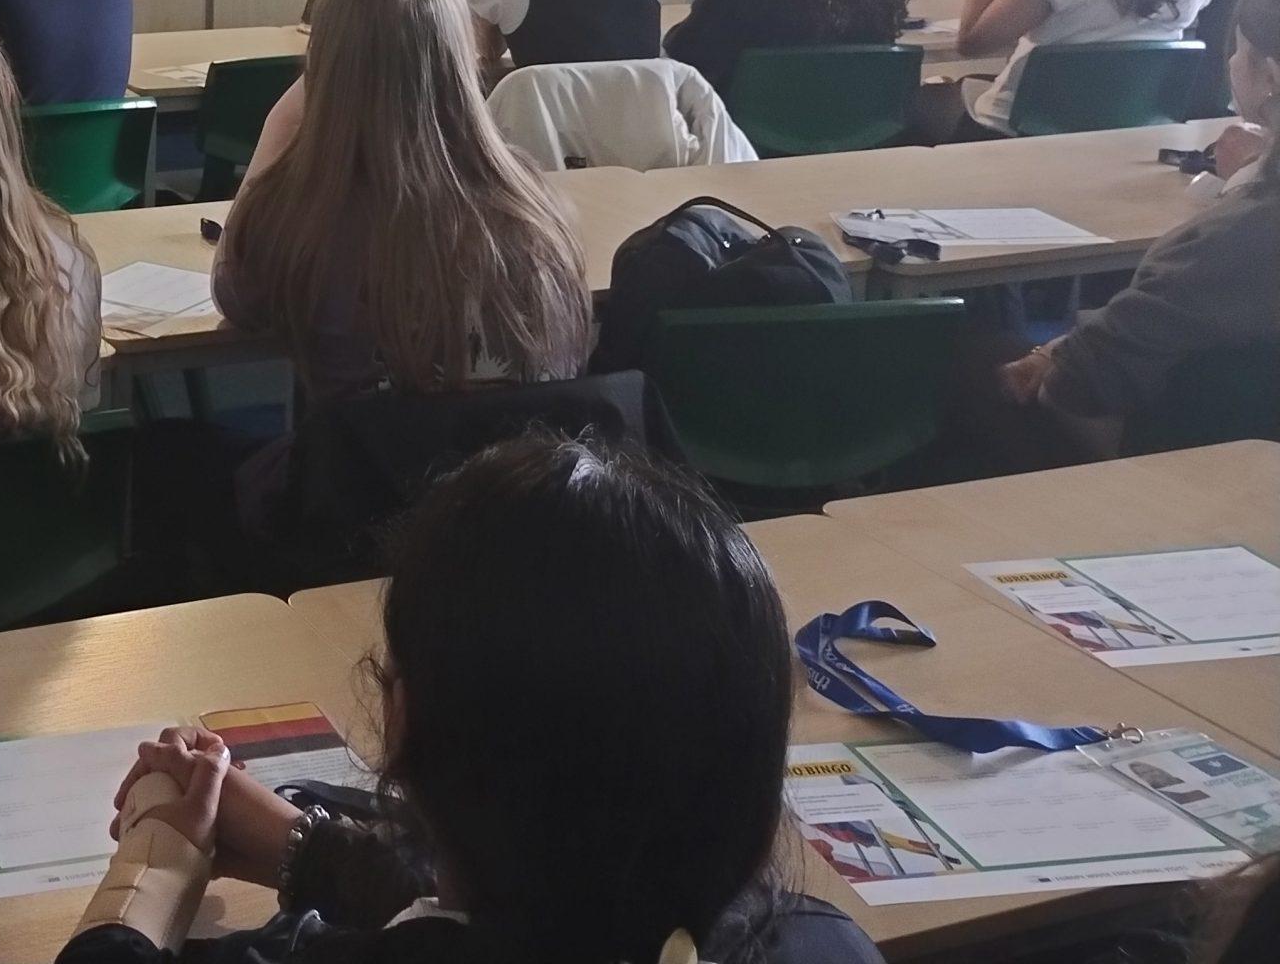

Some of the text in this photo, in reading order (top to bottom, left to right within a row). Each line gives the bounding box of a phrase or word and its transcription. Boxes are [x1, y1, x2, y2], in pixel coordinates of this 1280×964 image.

[997, 572, 1068, 583] EURO BINGO
[804, 764, 852, 775] BINGO
